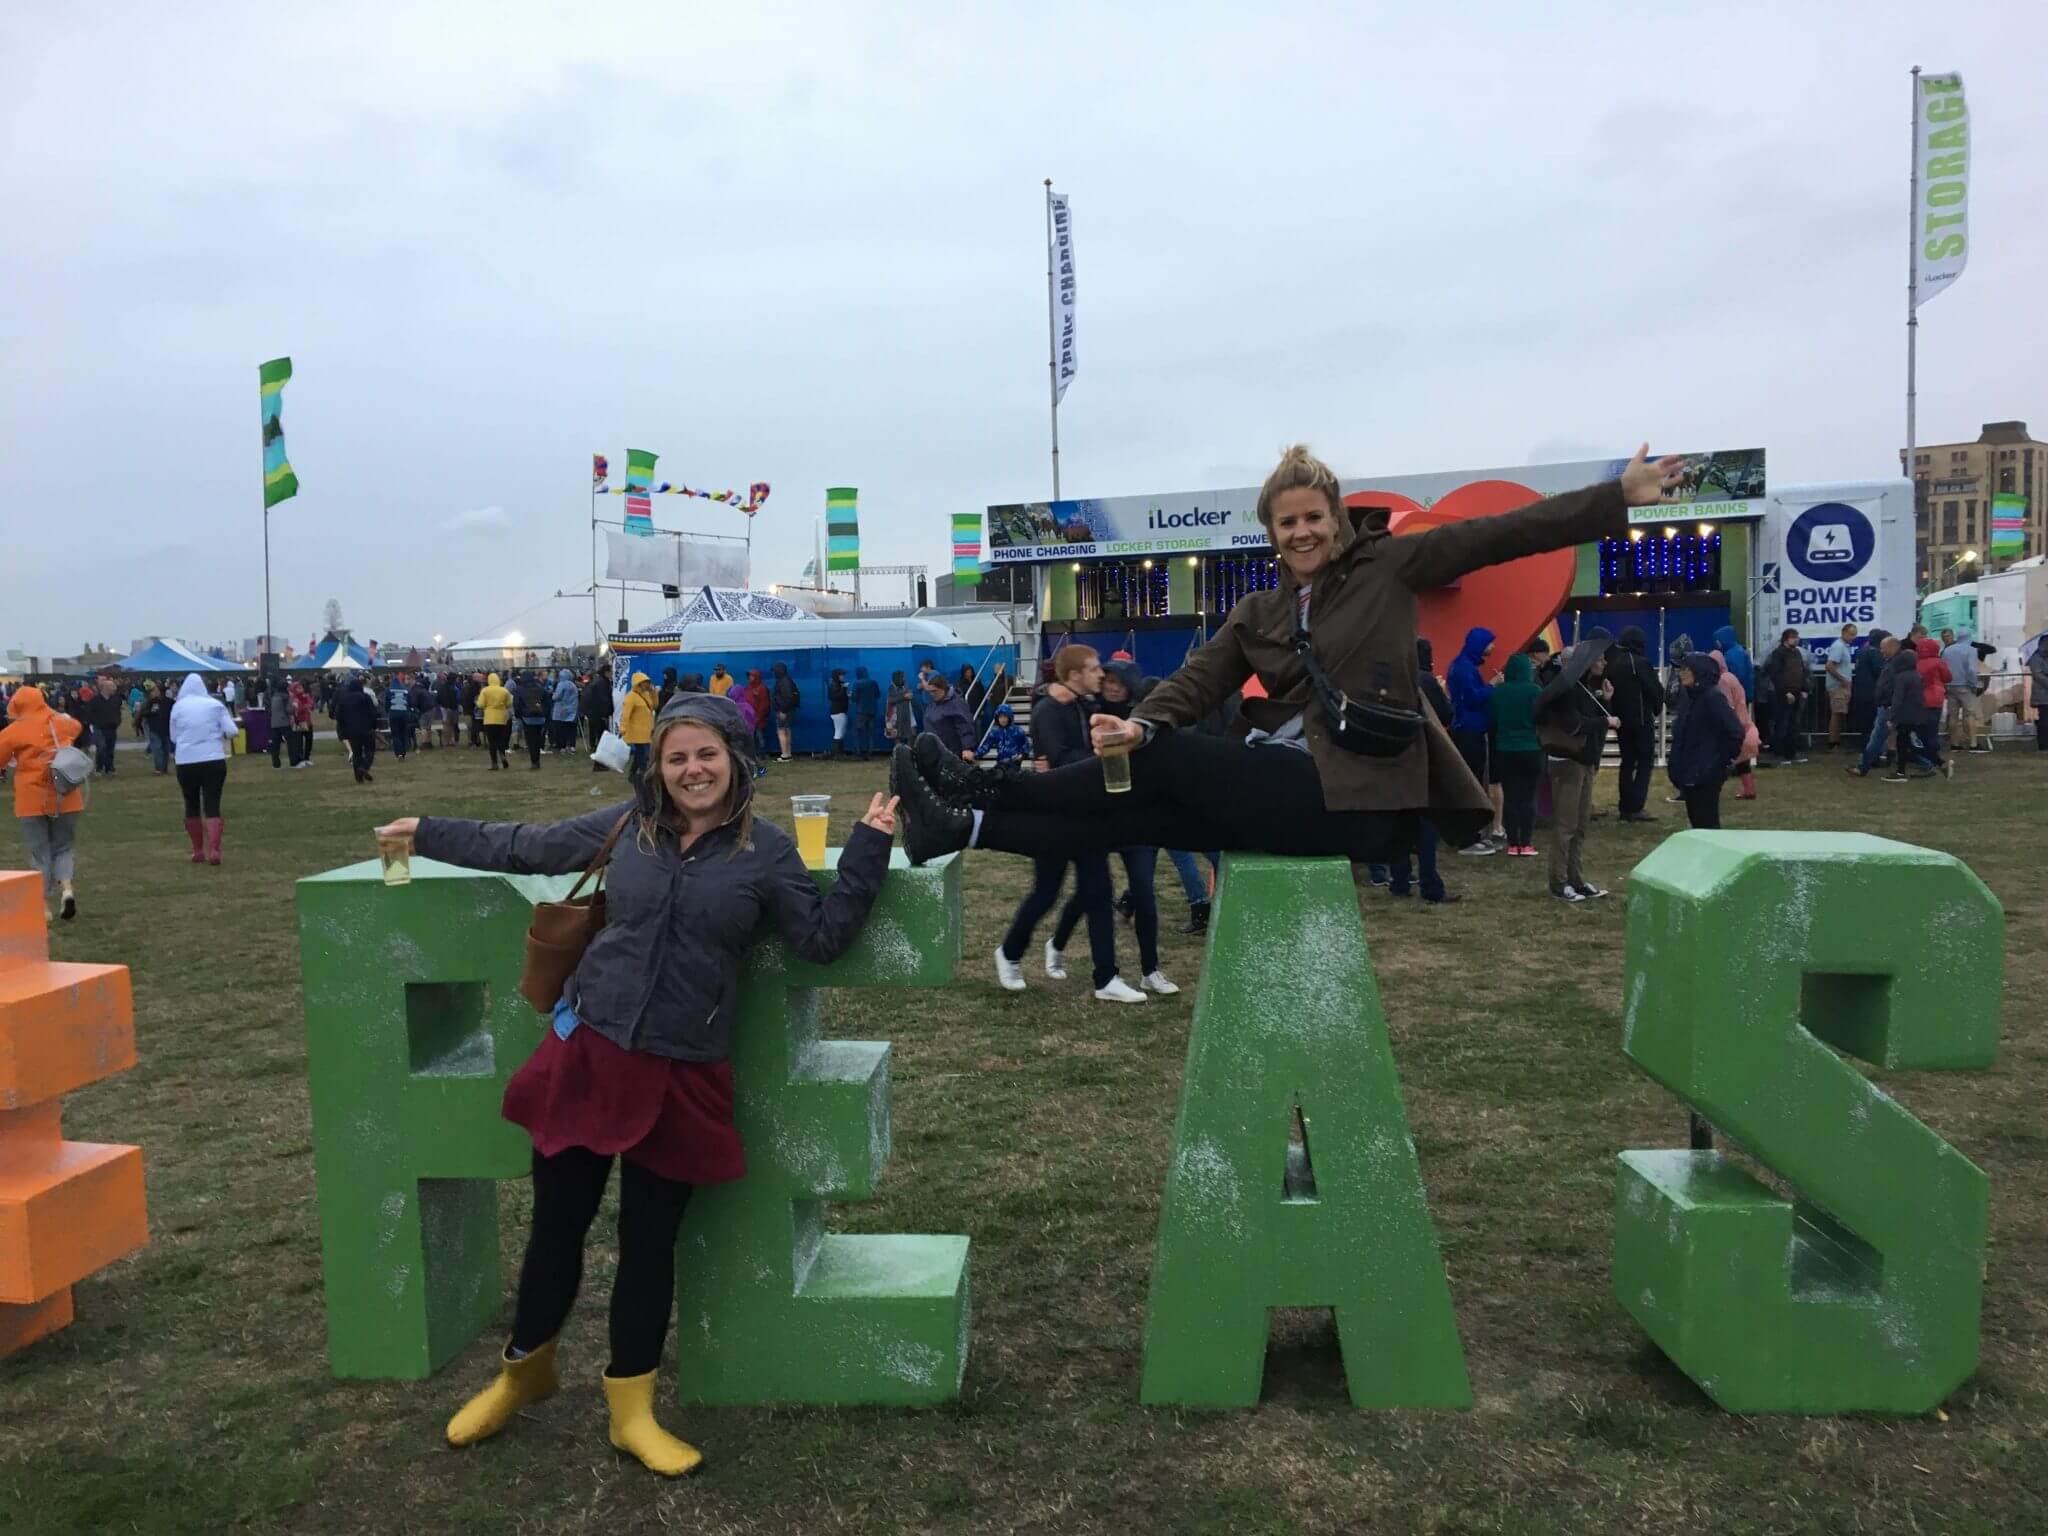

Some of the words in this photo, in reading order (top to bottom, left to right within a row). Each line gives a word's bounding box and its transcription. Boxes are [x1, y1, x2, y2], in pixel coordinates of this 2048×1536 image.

[1923, 75, 1967, 261] STORAGE
[1061, 313, 1075, 379] PHONE
[1148, 507, 1231, 530] iLocker
[1633, 505, 1689, 521] POWER
[1694, 502, 1748, 516] BANKS
[994, 547, 1033, 560] PHONE
[1036, 544, 1097, 558] CHARGING
[1106, 541, 1153, 553] LOCKER
[1156, 537, 1212, 551] STORAGE
[1231, 533, 1270, 546] POWE
[1784, 585, 1877, 606] POWER
[1786, 605, 1875, 625] BANKS
[297, 830, 2003, 1418] PEAS
